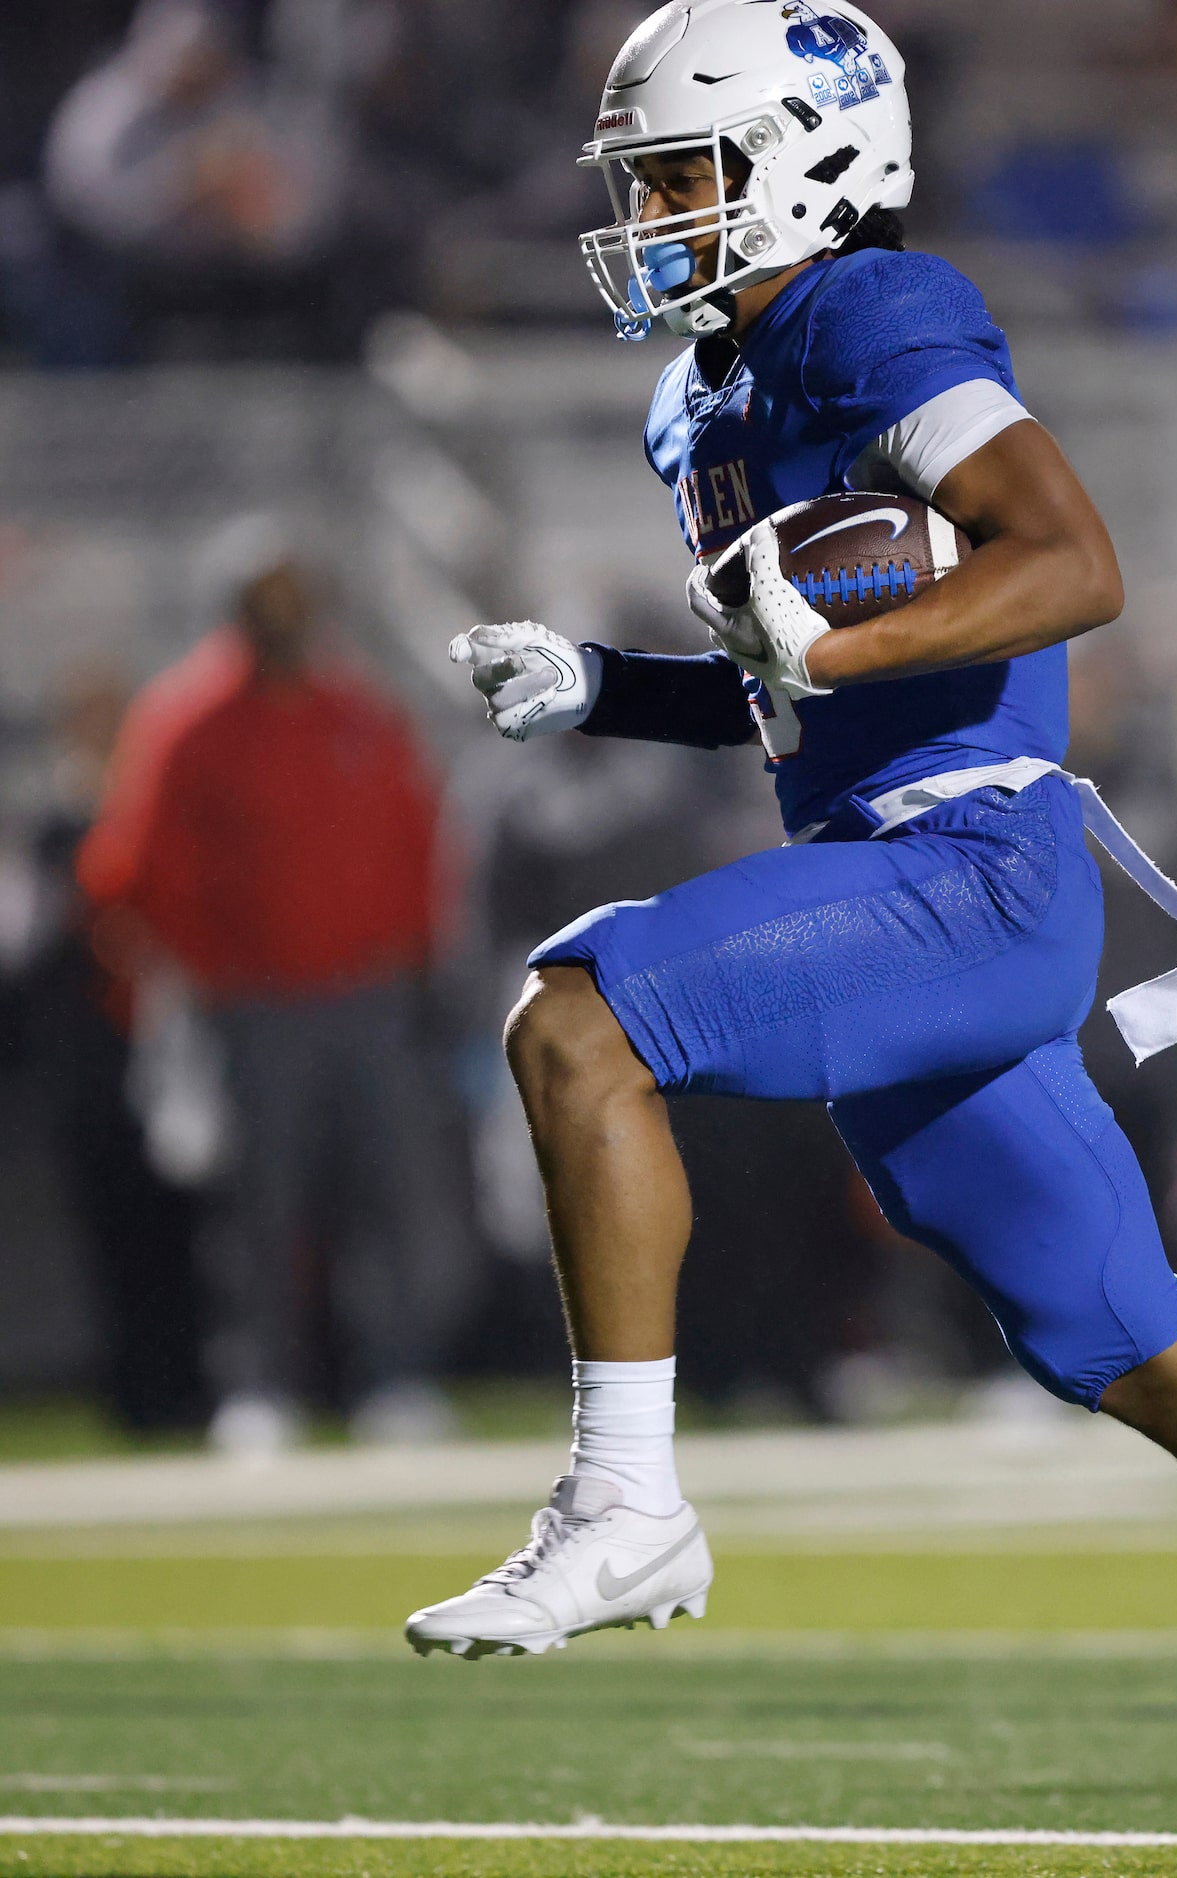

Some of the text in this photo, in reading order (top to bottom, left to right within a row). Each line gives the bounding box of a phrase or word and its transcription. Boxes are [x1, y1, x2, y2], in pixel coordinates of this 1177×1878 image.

[809, 24, 835, 47] A
[814, 88, 832, 102] 2008
[840, 91, 856, 104] 2012
[678, 459, 755, 547] LLEN
